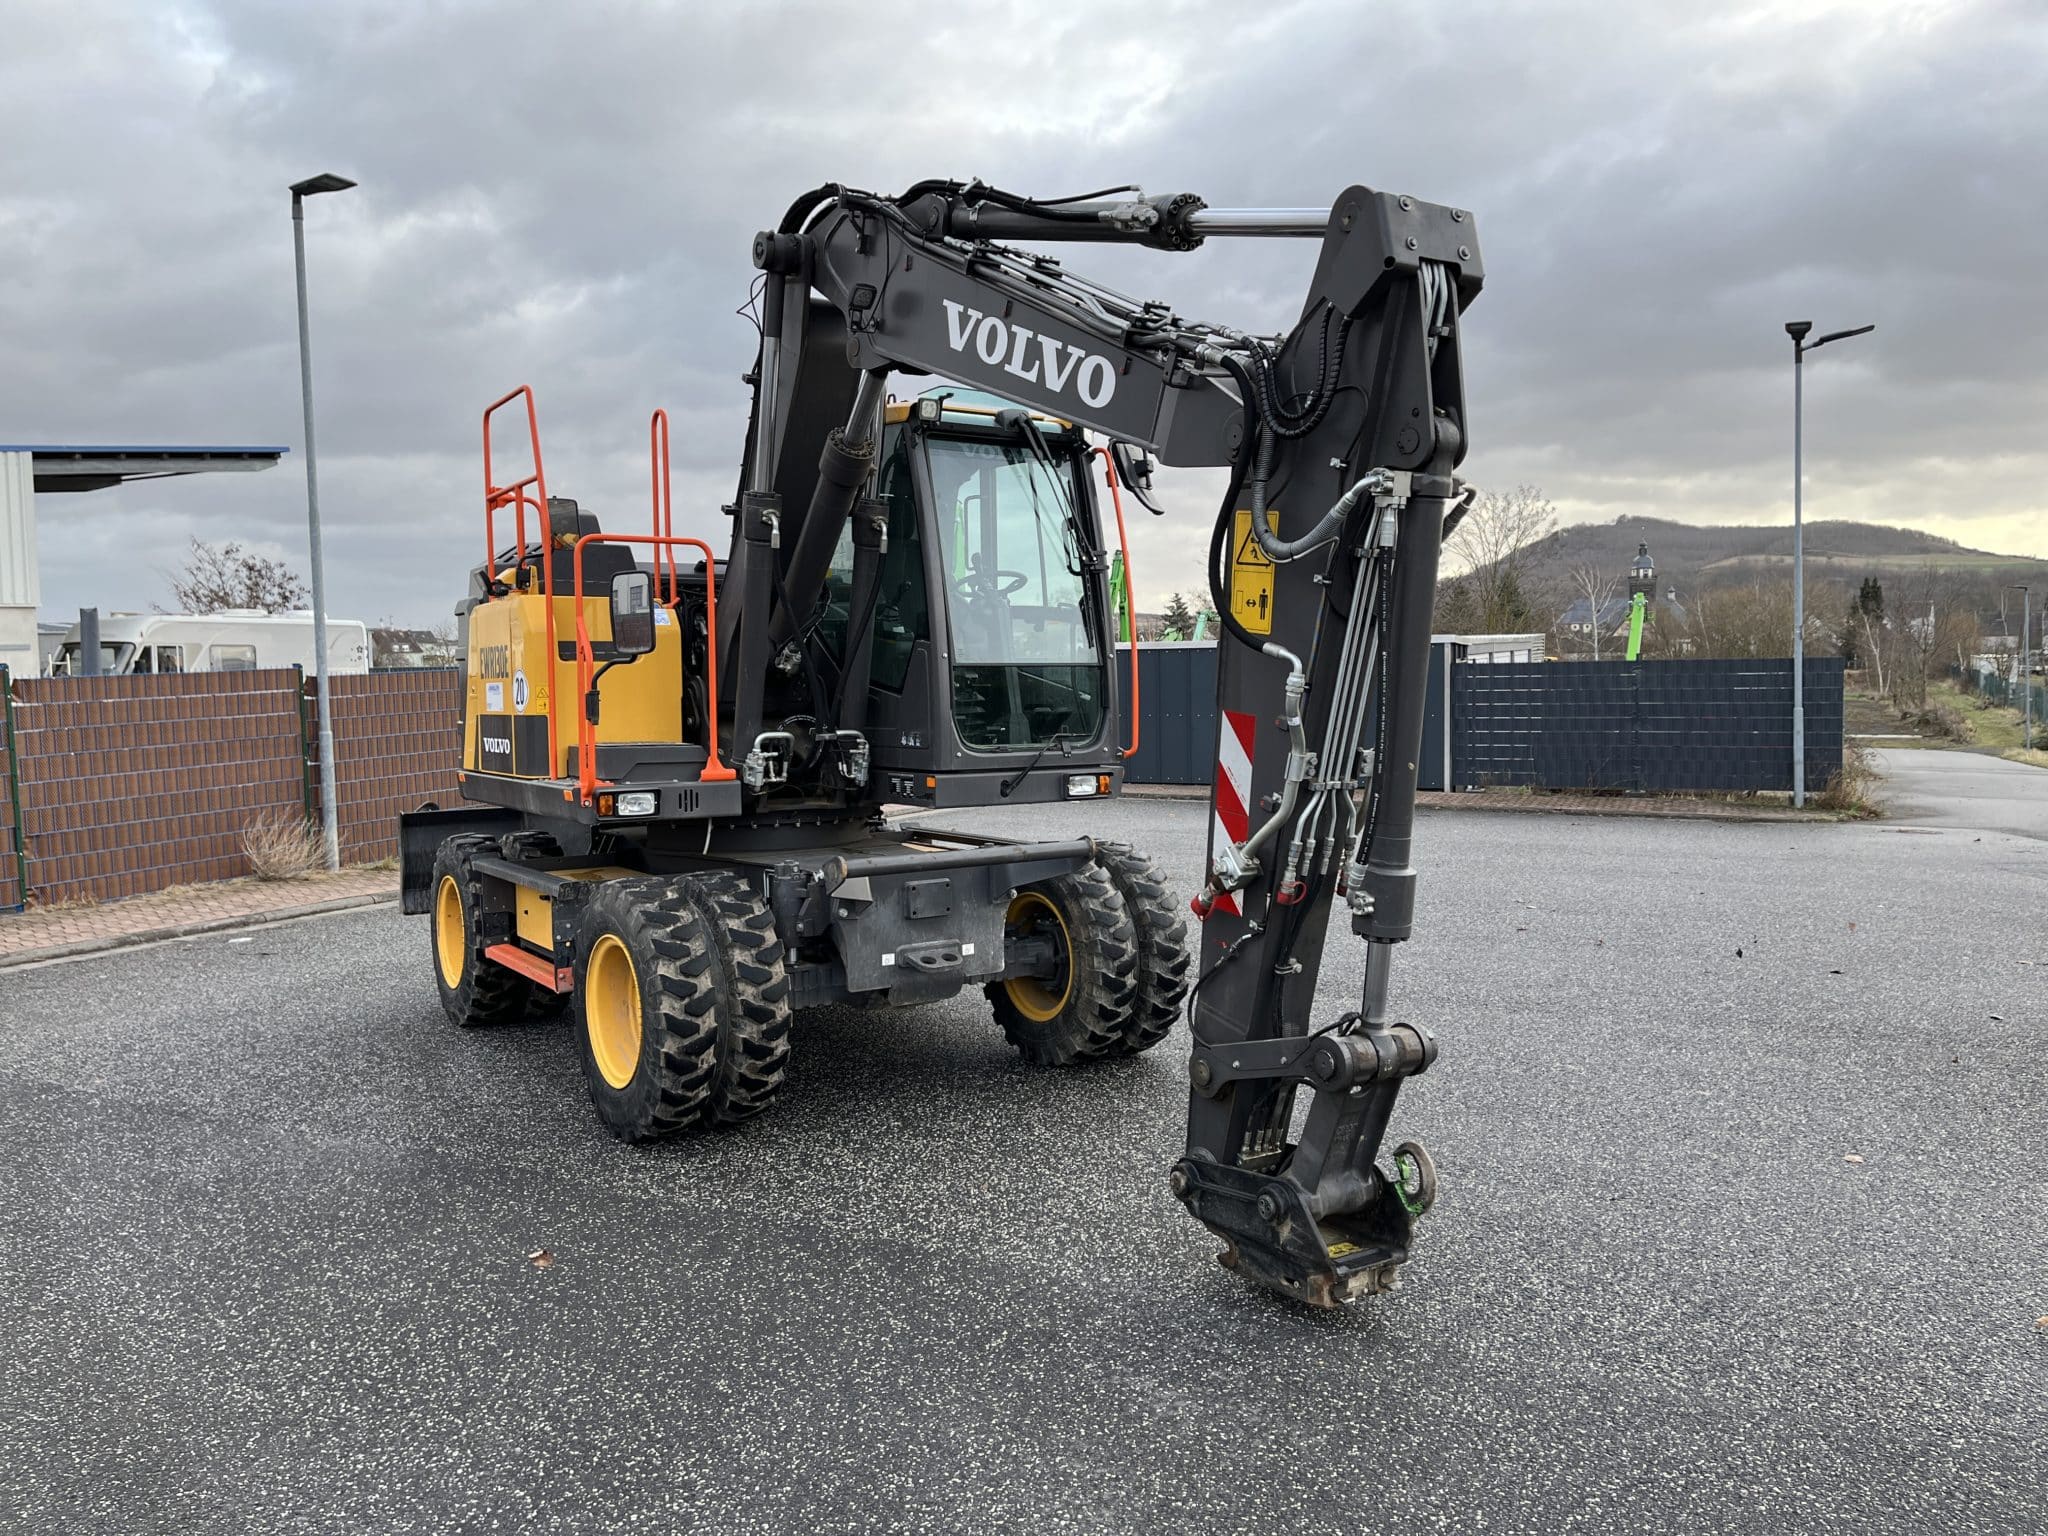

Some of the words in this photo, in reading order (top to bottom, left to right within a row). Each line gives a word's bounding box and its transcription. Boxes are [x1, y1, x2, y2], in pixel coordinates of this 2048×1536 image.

[942, 299, 1116, 409] VOLVO
[480, 645, 509, 680] EWR130E
[515, 678, 525, 705] 20
[483, 737, 511, 754] VOLVO
